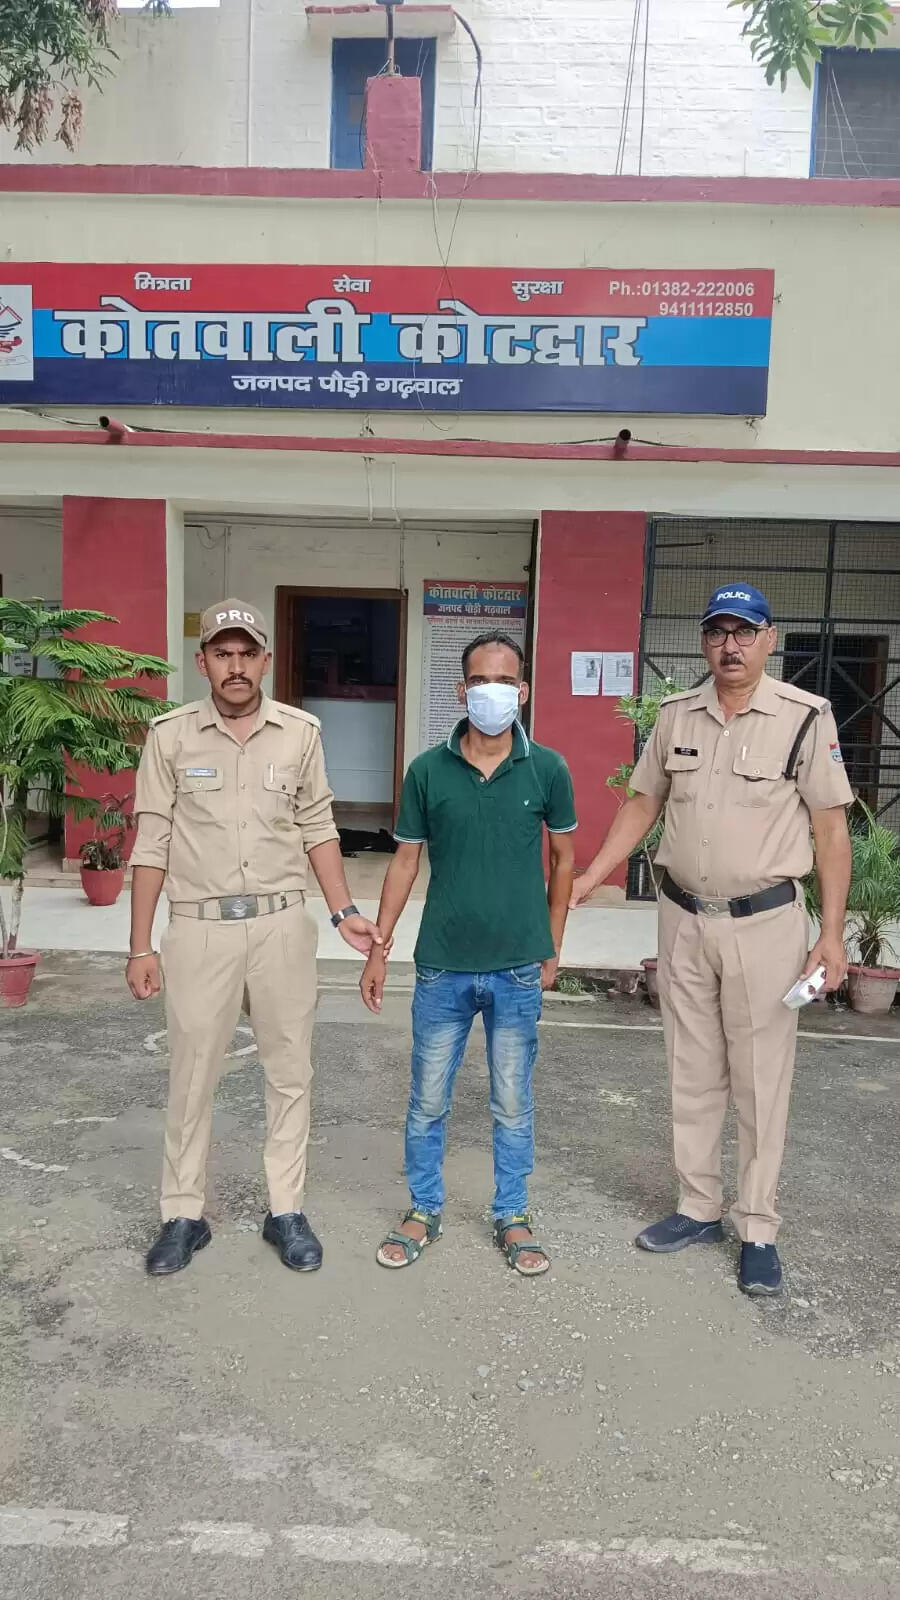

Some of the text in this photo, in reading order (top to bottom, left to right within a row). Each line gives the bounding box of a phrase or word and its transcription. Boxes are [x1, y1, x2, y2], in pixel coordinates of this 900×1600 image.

[134, 272, 192, 291] मित्रता
[332, 274, 372, 293] सेवा
[511, 280, 564, 302] सुरक्षा
[609, 280, 755, 298] Ph.:01382-222006
[659, 302, 754, 317] 9411112850
[52, 295, 648, 366] कोतवाली कोटद्वार
[231, 370, 463, 399] जनपद पौड़ी गढ़वाल
[716, 591, 751, 602] POLICE
[215, 609, 255, 625] PRD
